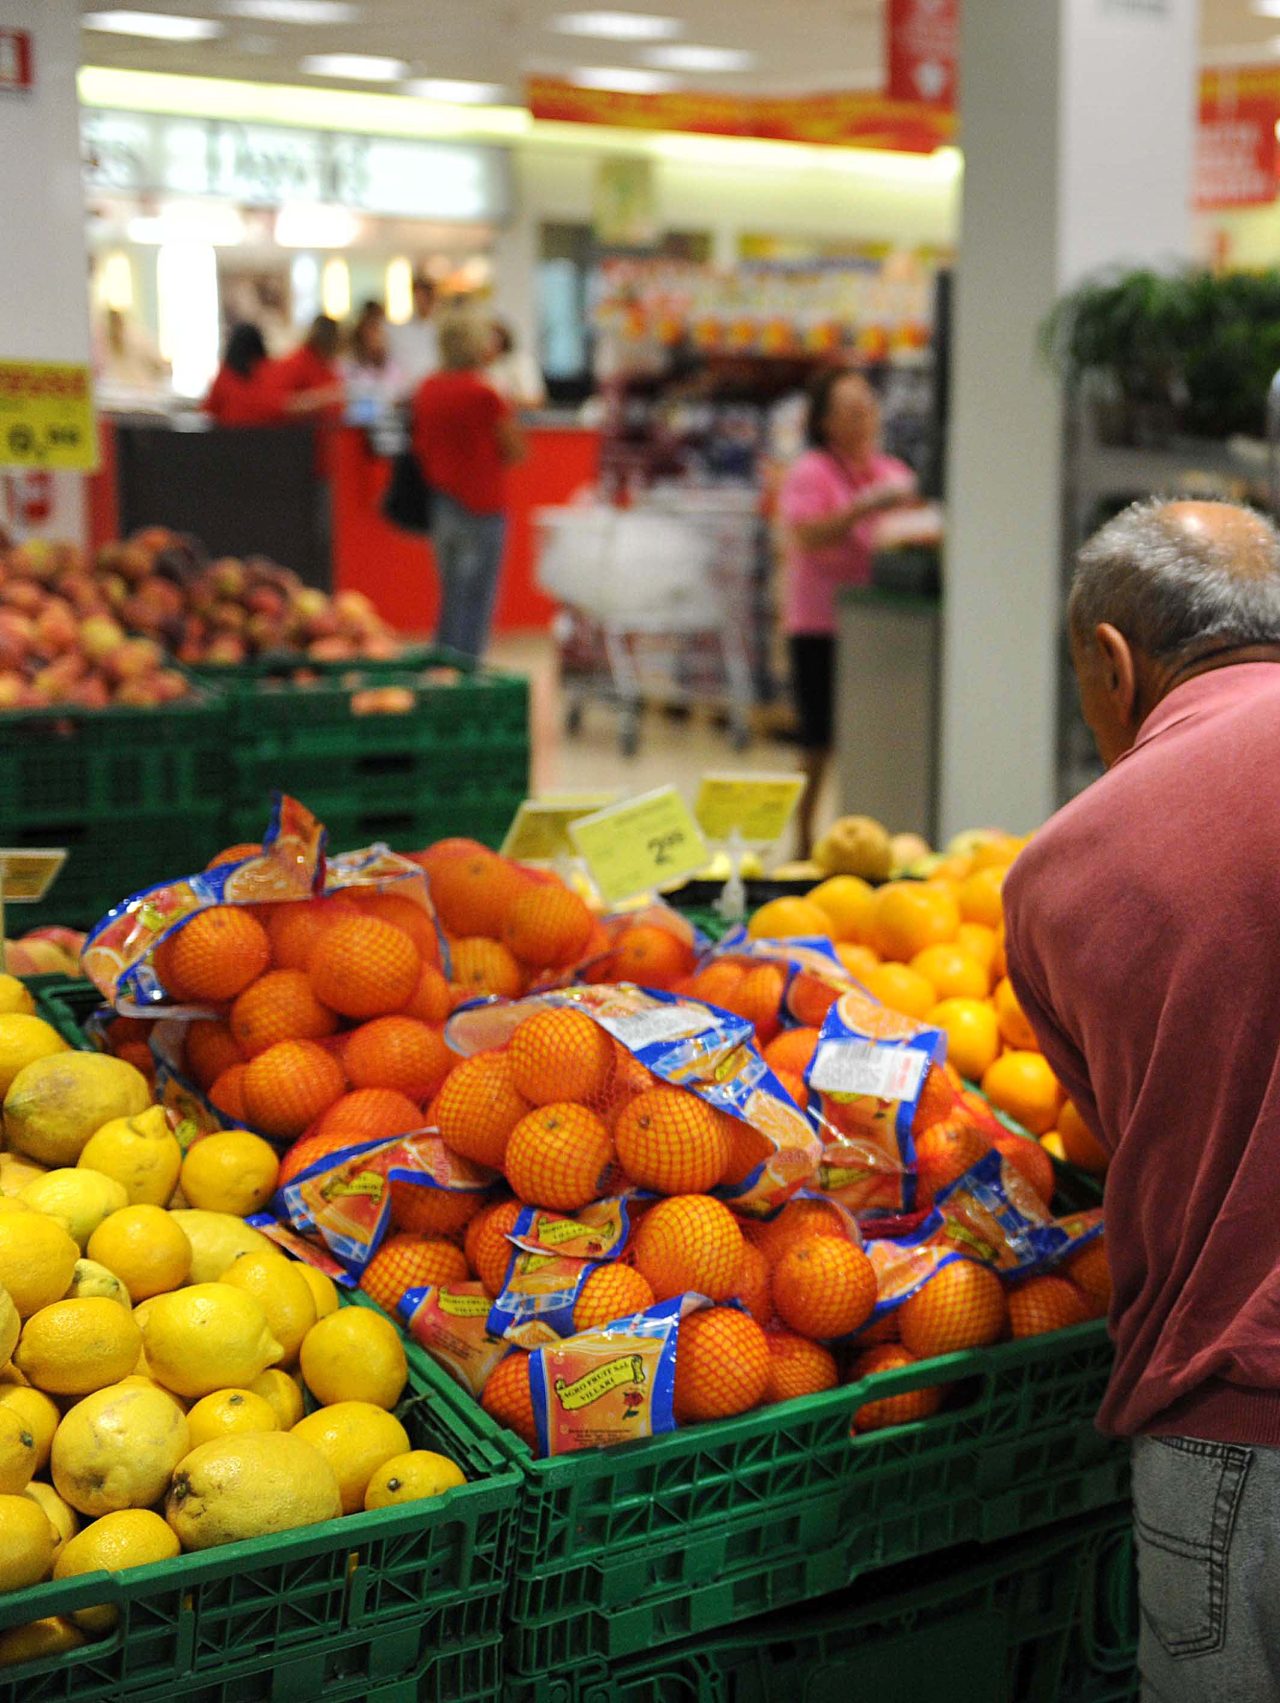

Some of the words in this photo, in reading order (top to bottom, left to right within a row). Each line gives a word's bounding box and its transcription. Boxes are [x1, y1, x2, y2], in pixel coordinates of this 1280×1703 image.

[563, 1382, 587, 1399] AGRO
[586, 1368, 613, 1387] FRUIT
[579, 1376, 615, 1401] VILLARI
